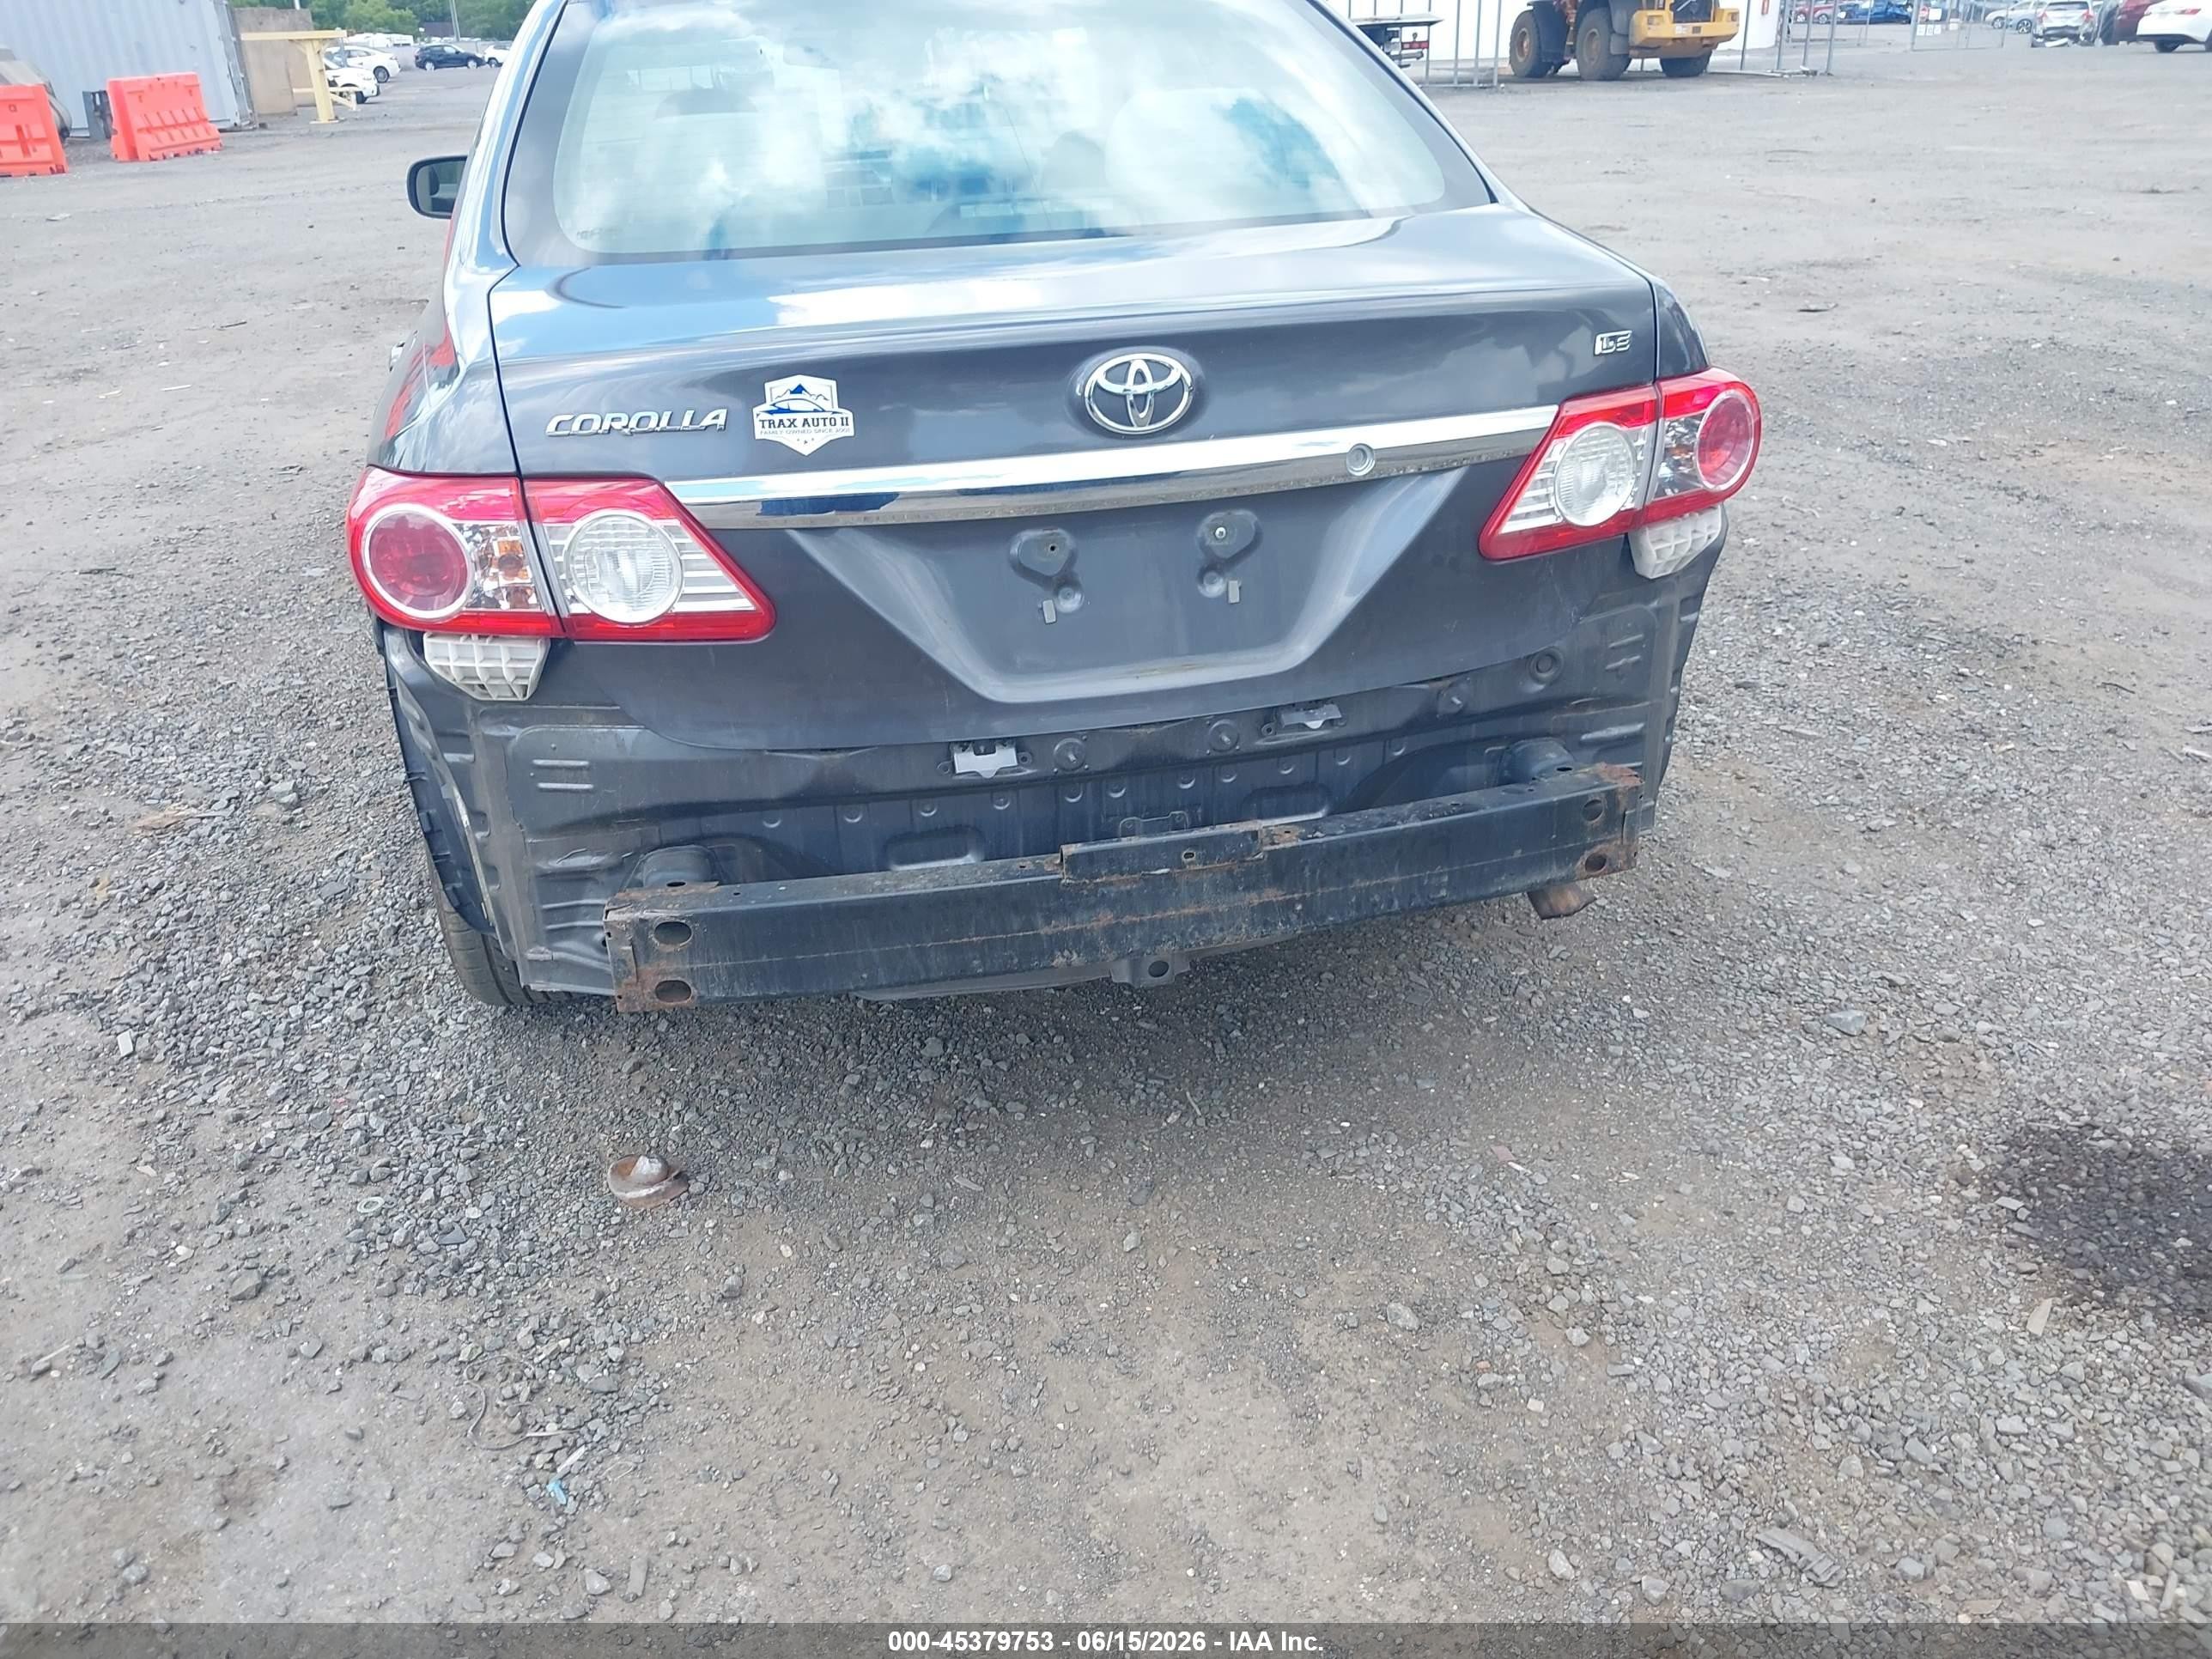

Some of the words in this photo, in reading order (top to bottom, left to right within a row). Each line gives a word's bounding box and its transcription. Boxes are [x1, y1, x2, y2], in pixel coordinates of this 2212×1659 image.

[1594, 330, 1632, 356] LE
[544, 408, 728, 436] COROLLA
[759, 418, 797, 429] TRAX
[801, 416, 836, 428] AUTO
[841, 416, 849, 427] II
